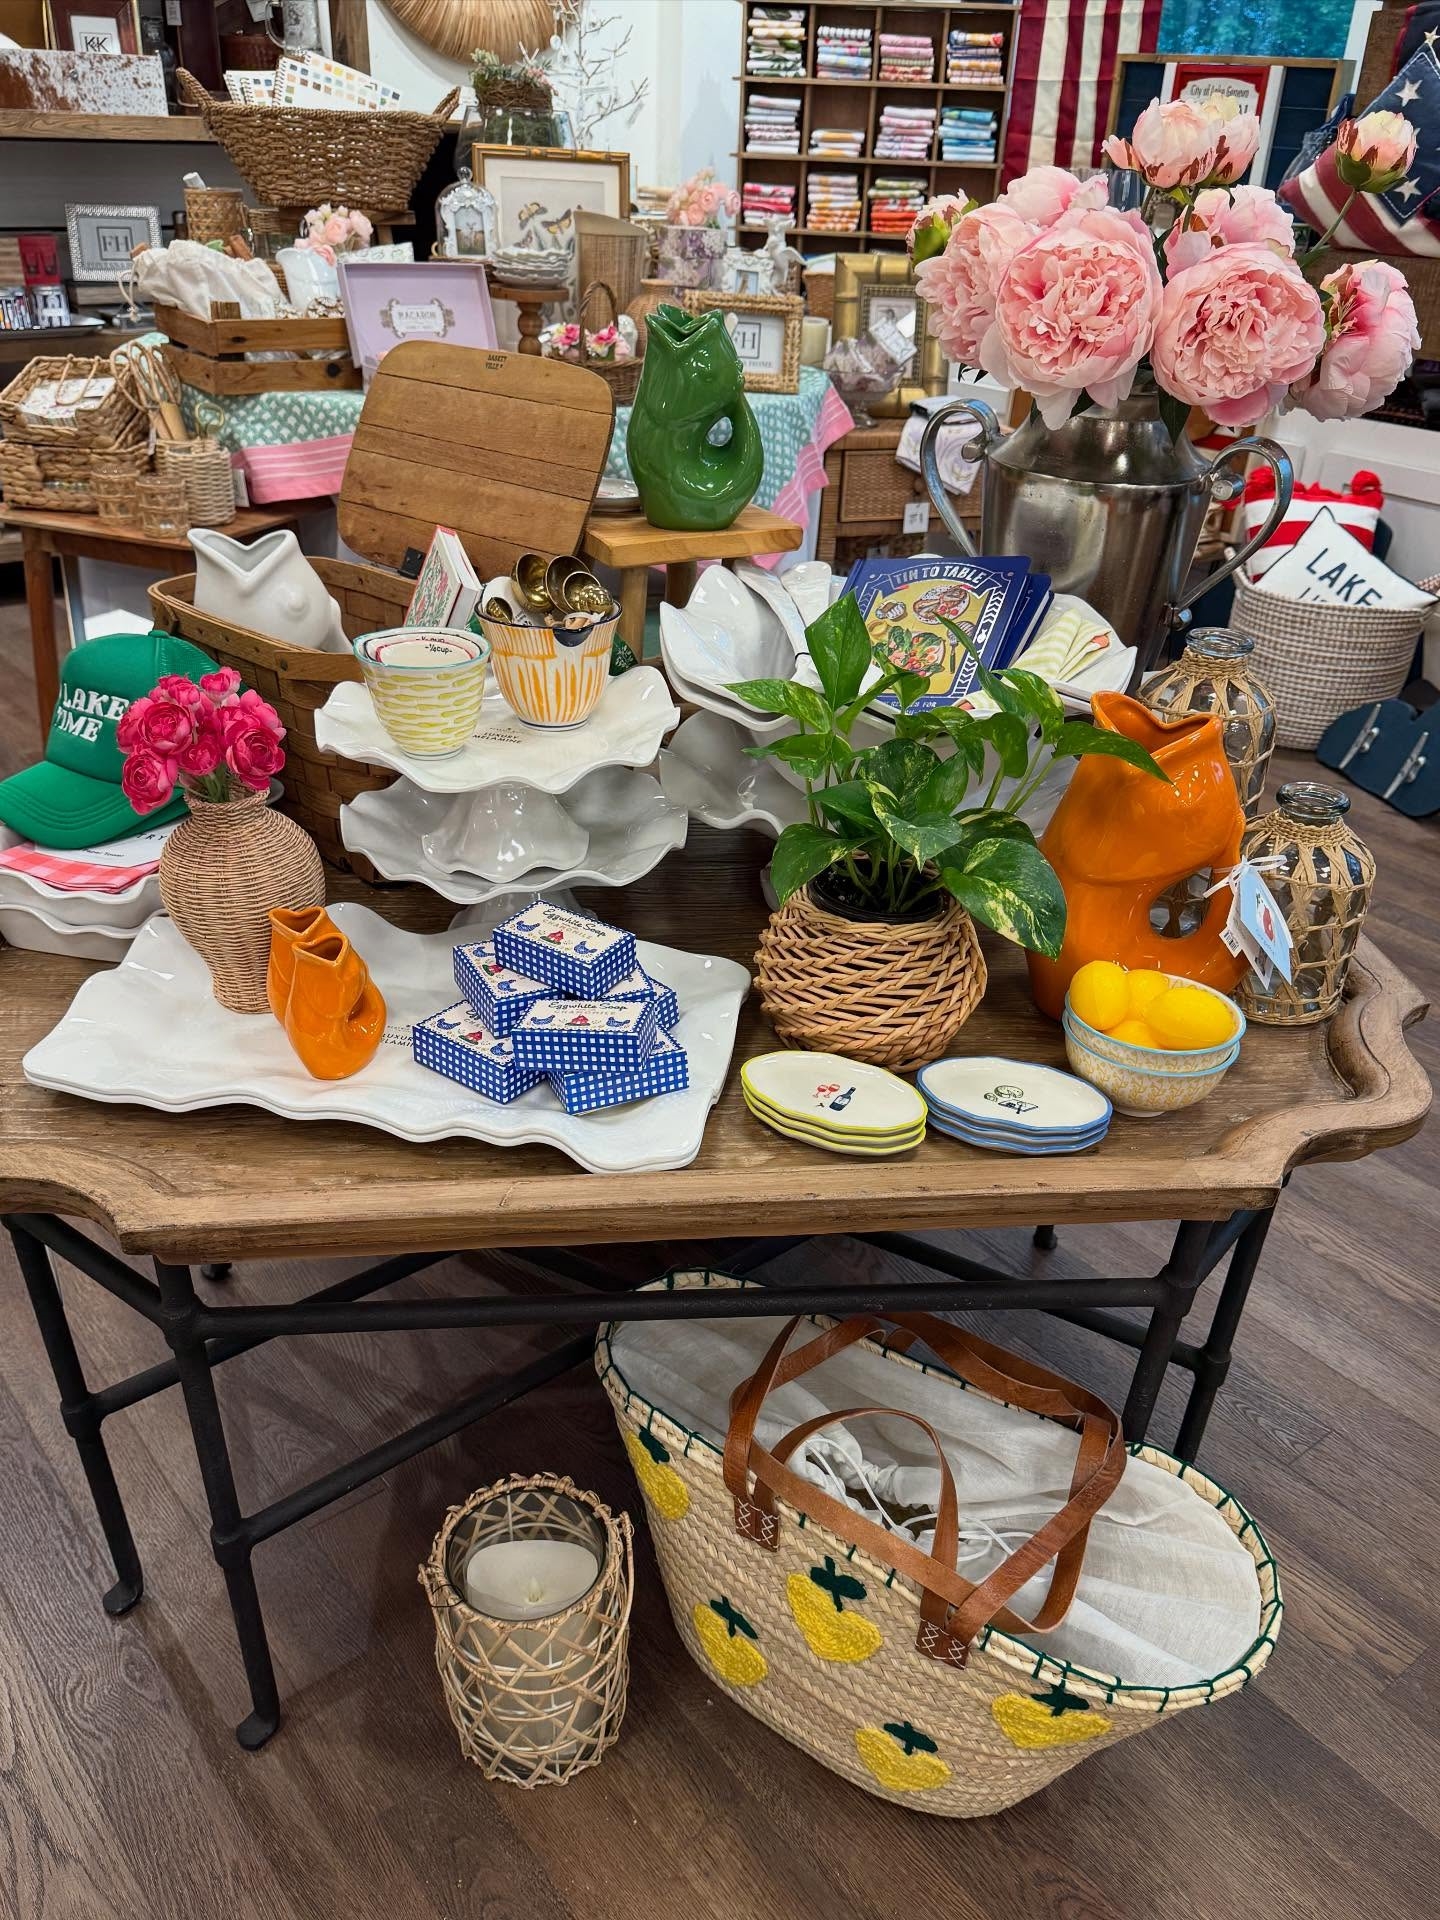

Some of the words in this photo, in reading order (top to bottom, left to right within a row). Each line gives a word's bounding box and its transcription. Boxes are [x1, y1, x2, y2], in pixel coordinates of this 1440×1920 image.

[1191, 84, 1202, 97] City
[893, 569, 918, 585] TIN
[922, 565, 940, 578] TO
[942, 565, 988, 584] TABLE
[62, 683, 130, 721] LAKE
[54, 706, 103, 742] TIME
[542, 908, 583, 928] Eggwhite
[583, 922, 607, 938] Soap
[548, 1001, 597, 1010] Eggwhite
[598, 1002, 628, 1012] Soap
